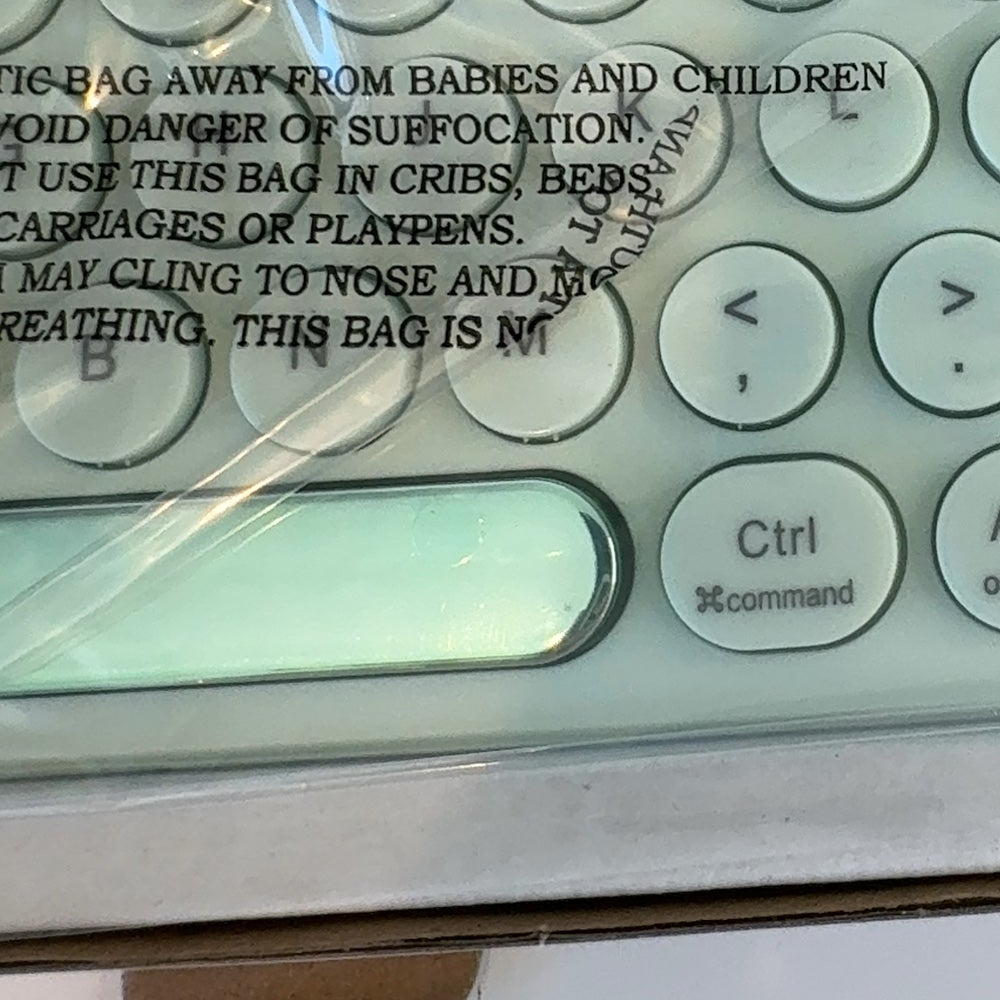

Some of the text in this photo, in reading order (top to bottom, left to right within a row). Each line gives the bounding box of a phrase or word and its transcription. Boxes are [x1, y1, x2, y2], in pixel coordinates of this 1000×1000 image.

[64, 64, 153, 96] BAG
[162, 64, 276, 96] AWAY
[284, 64, 394, 97] FROM
[408, 64, 559, 96] BABIES
[571, 61, 658, 95] AND
[673, 60, 888, 95] CHILDREN
[103, 112, 268, 144] DANGER
[279, 114, 338, 146] OF
[348, 112, 645, 146] SUFFOCATION.
[38, 161, 120, 193] USE
[130, 160, 227, 192] THIS
[236, 162, 323, 194] BAG
[334, 164, 379, 195] IN
[390, 163, 523, 201] CRIBS,
[0, 208, 524, 246] CARRIAGES OR PLAYPENS.
[18, 259, 101, 293] MAY
[109, 257, 242, 295] CLING
[255, 263, 310, 296] TO
[321, 264, 437, 297] NOSE
[447, 265, 538, 297] AND
[0, 307, 216, 347] REATHING.
[233, 313, 330, 347] THIS
[341, 314, 430, 348] BAG
[440, 315, 483, 348] IS
[737, 516, 817, 559] Ctrl
[727, 580, 854, 614] command
